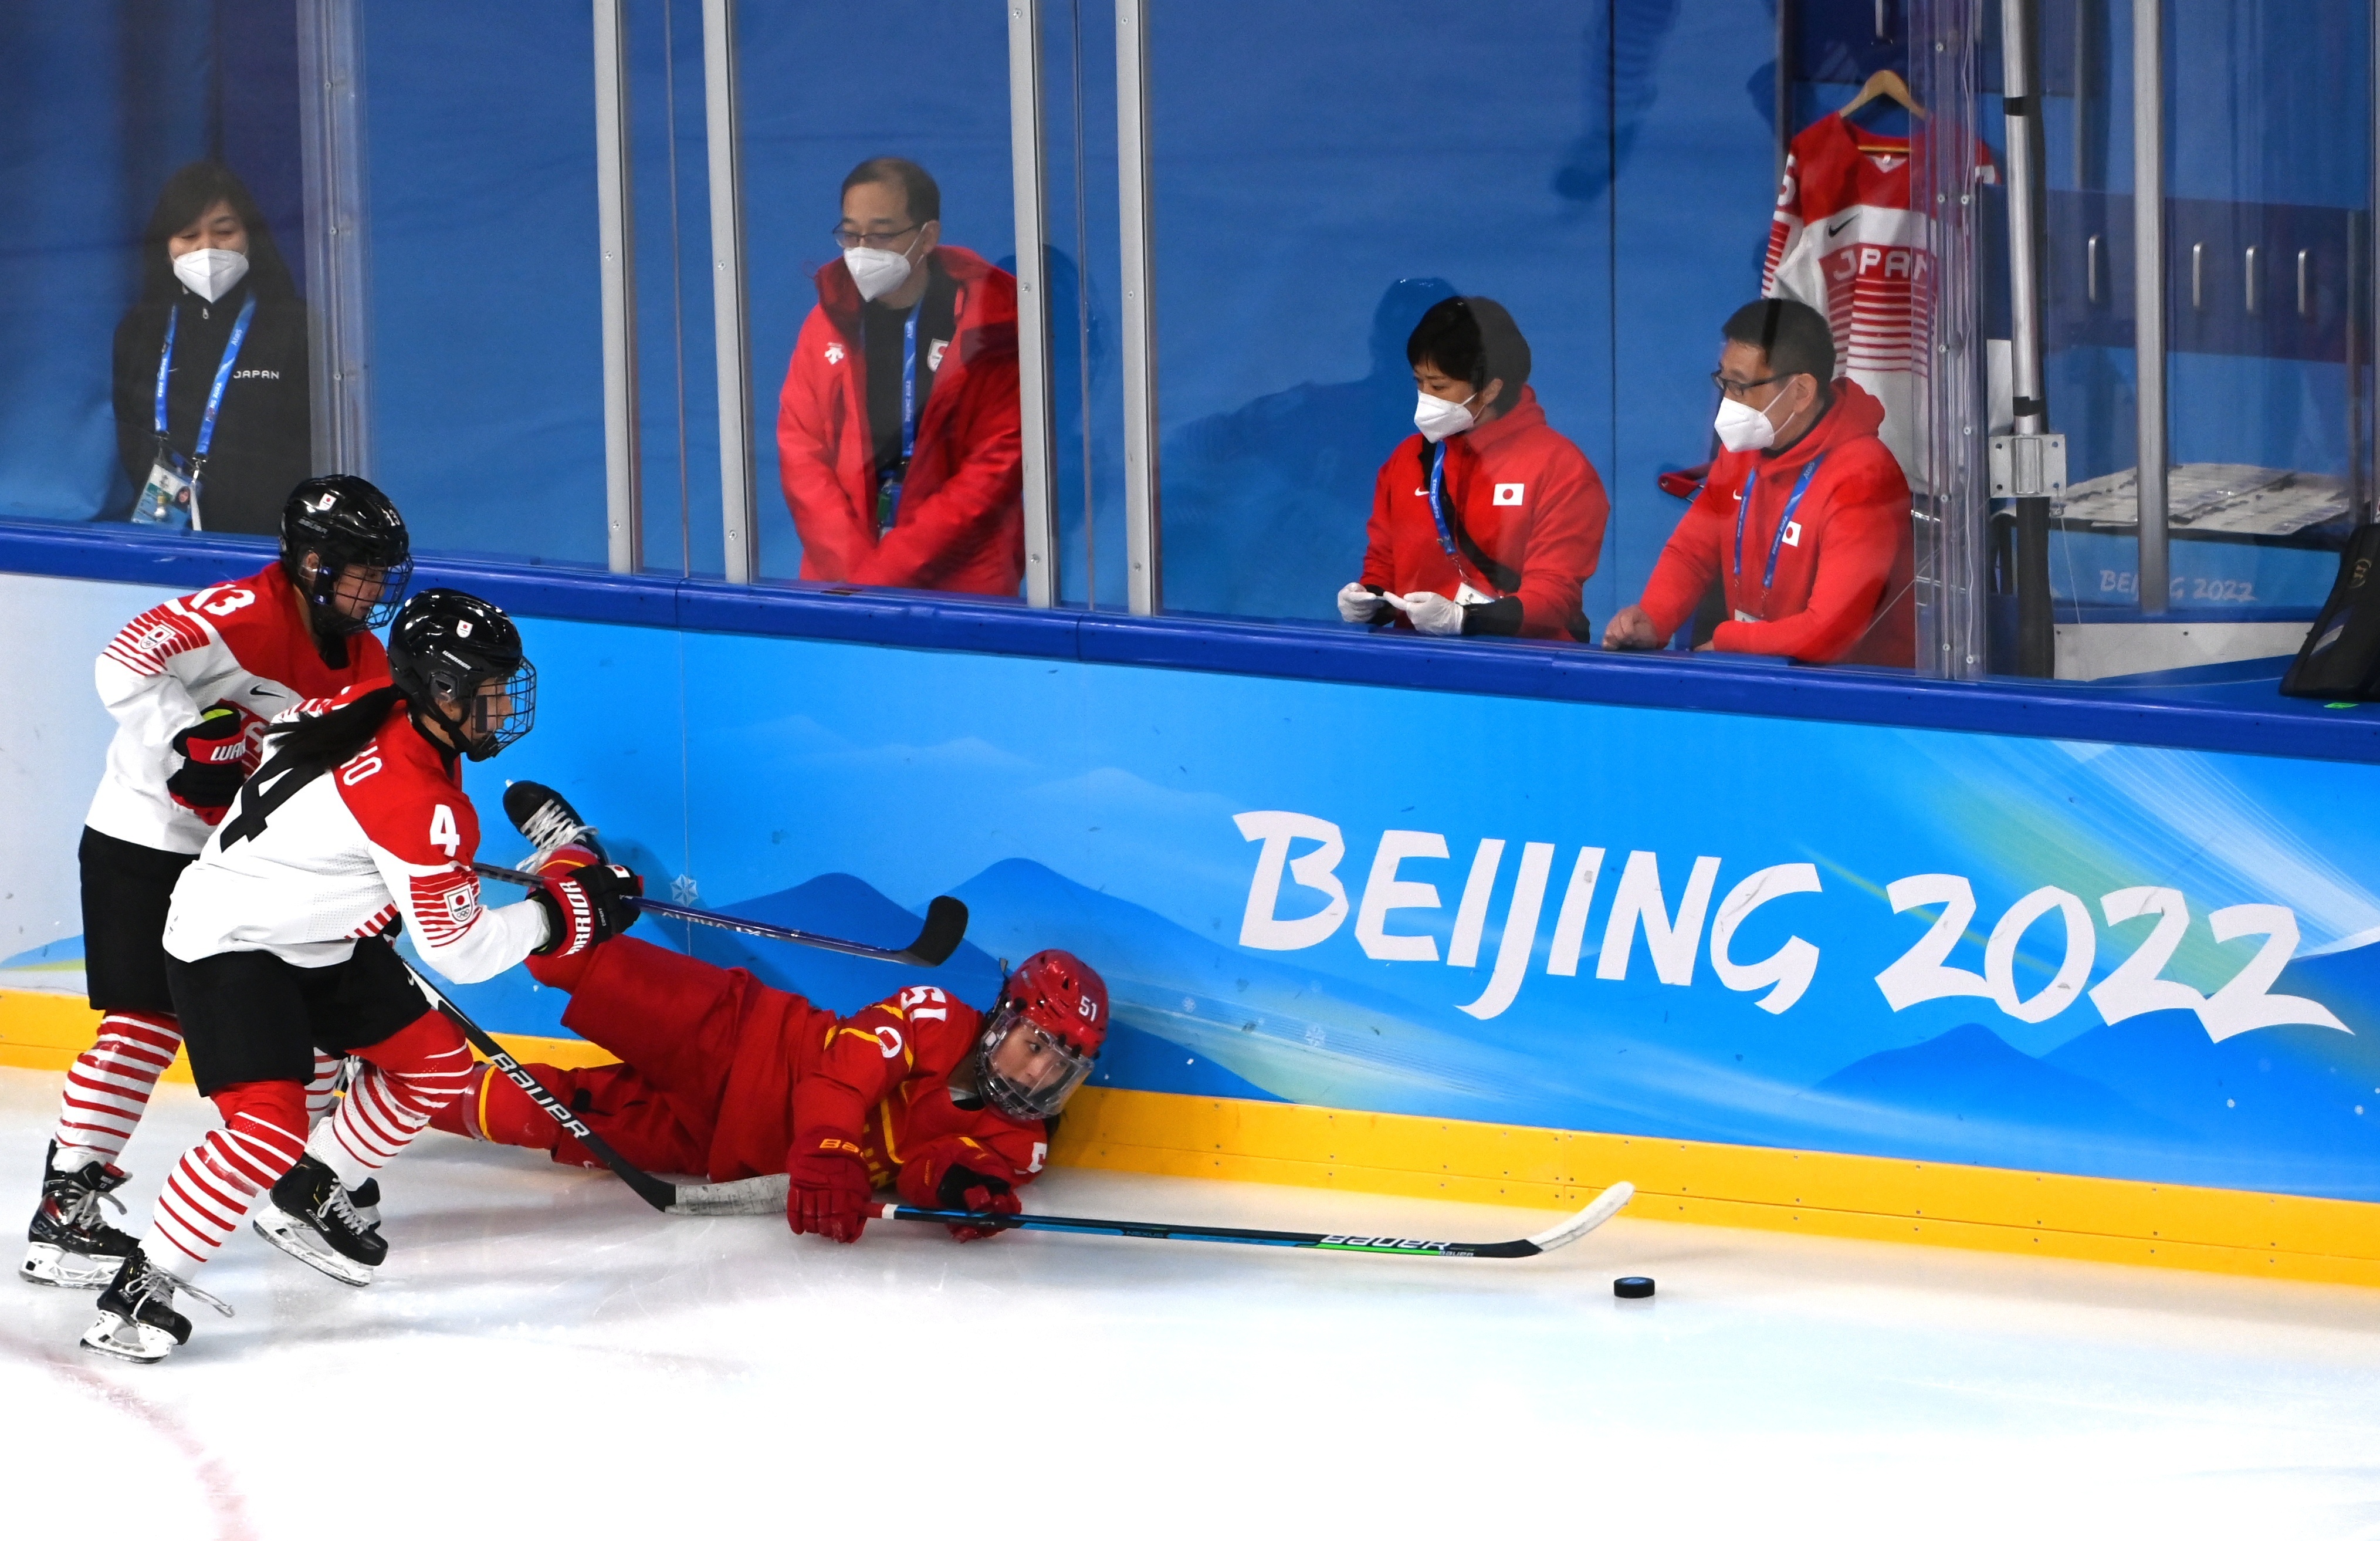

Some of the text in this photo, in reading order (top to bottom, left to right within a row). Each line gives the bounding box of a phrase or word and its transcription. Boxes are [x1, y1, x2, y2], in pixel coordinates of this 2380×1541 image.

[233, 370, 280, 380] JAPAN
[381, 508, 401, 527] 13
[189, 583, 256, 616] 13
[2193, 579, 2257, 603] 2022
[442, 650, 472, 670] WARRIOR
[219, 741, 329, 853] 4
[429, 803, 461, 857] 4
[1232, 810, 2355, 1043] BEIJING 2022
[900, 986, 946, 1022] 51
[1078, 996, 1097, 1022] 51
[489, 1052, 591, 1138] BAUER
